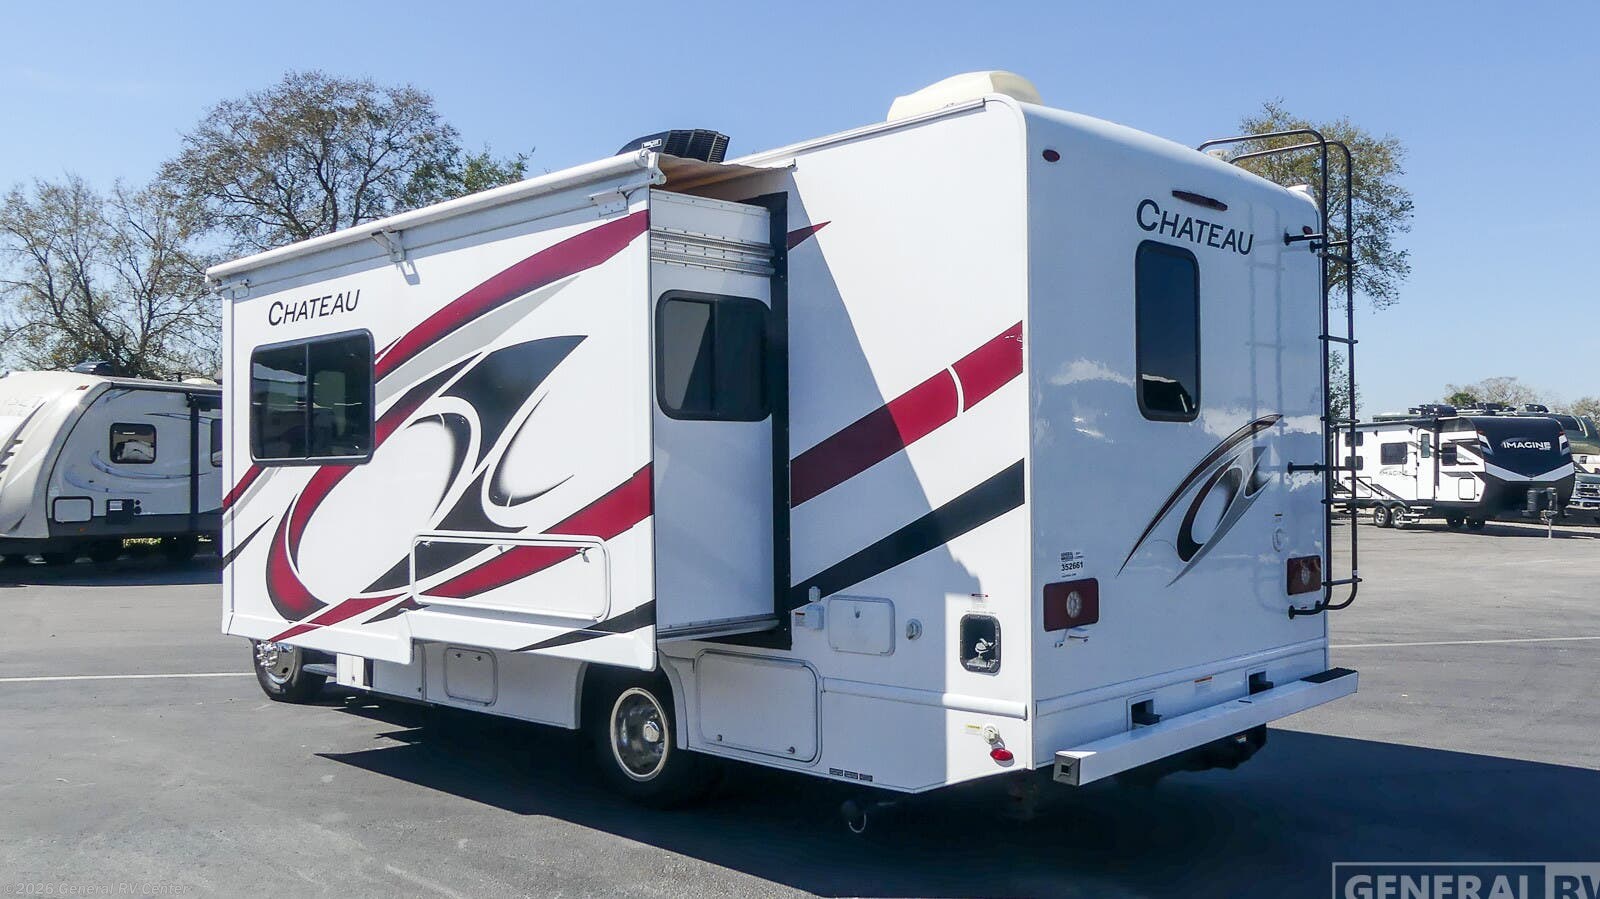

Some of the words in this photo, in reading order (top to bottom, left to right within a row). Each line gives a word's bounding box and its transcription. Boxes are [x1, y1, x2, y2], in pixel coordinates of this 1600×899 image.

[1136, 198, 1254, 255] CHATEAU
[268, 289, 360, 326] CHATEAU
[1503, 441, 1551, 449] IMAGINE
